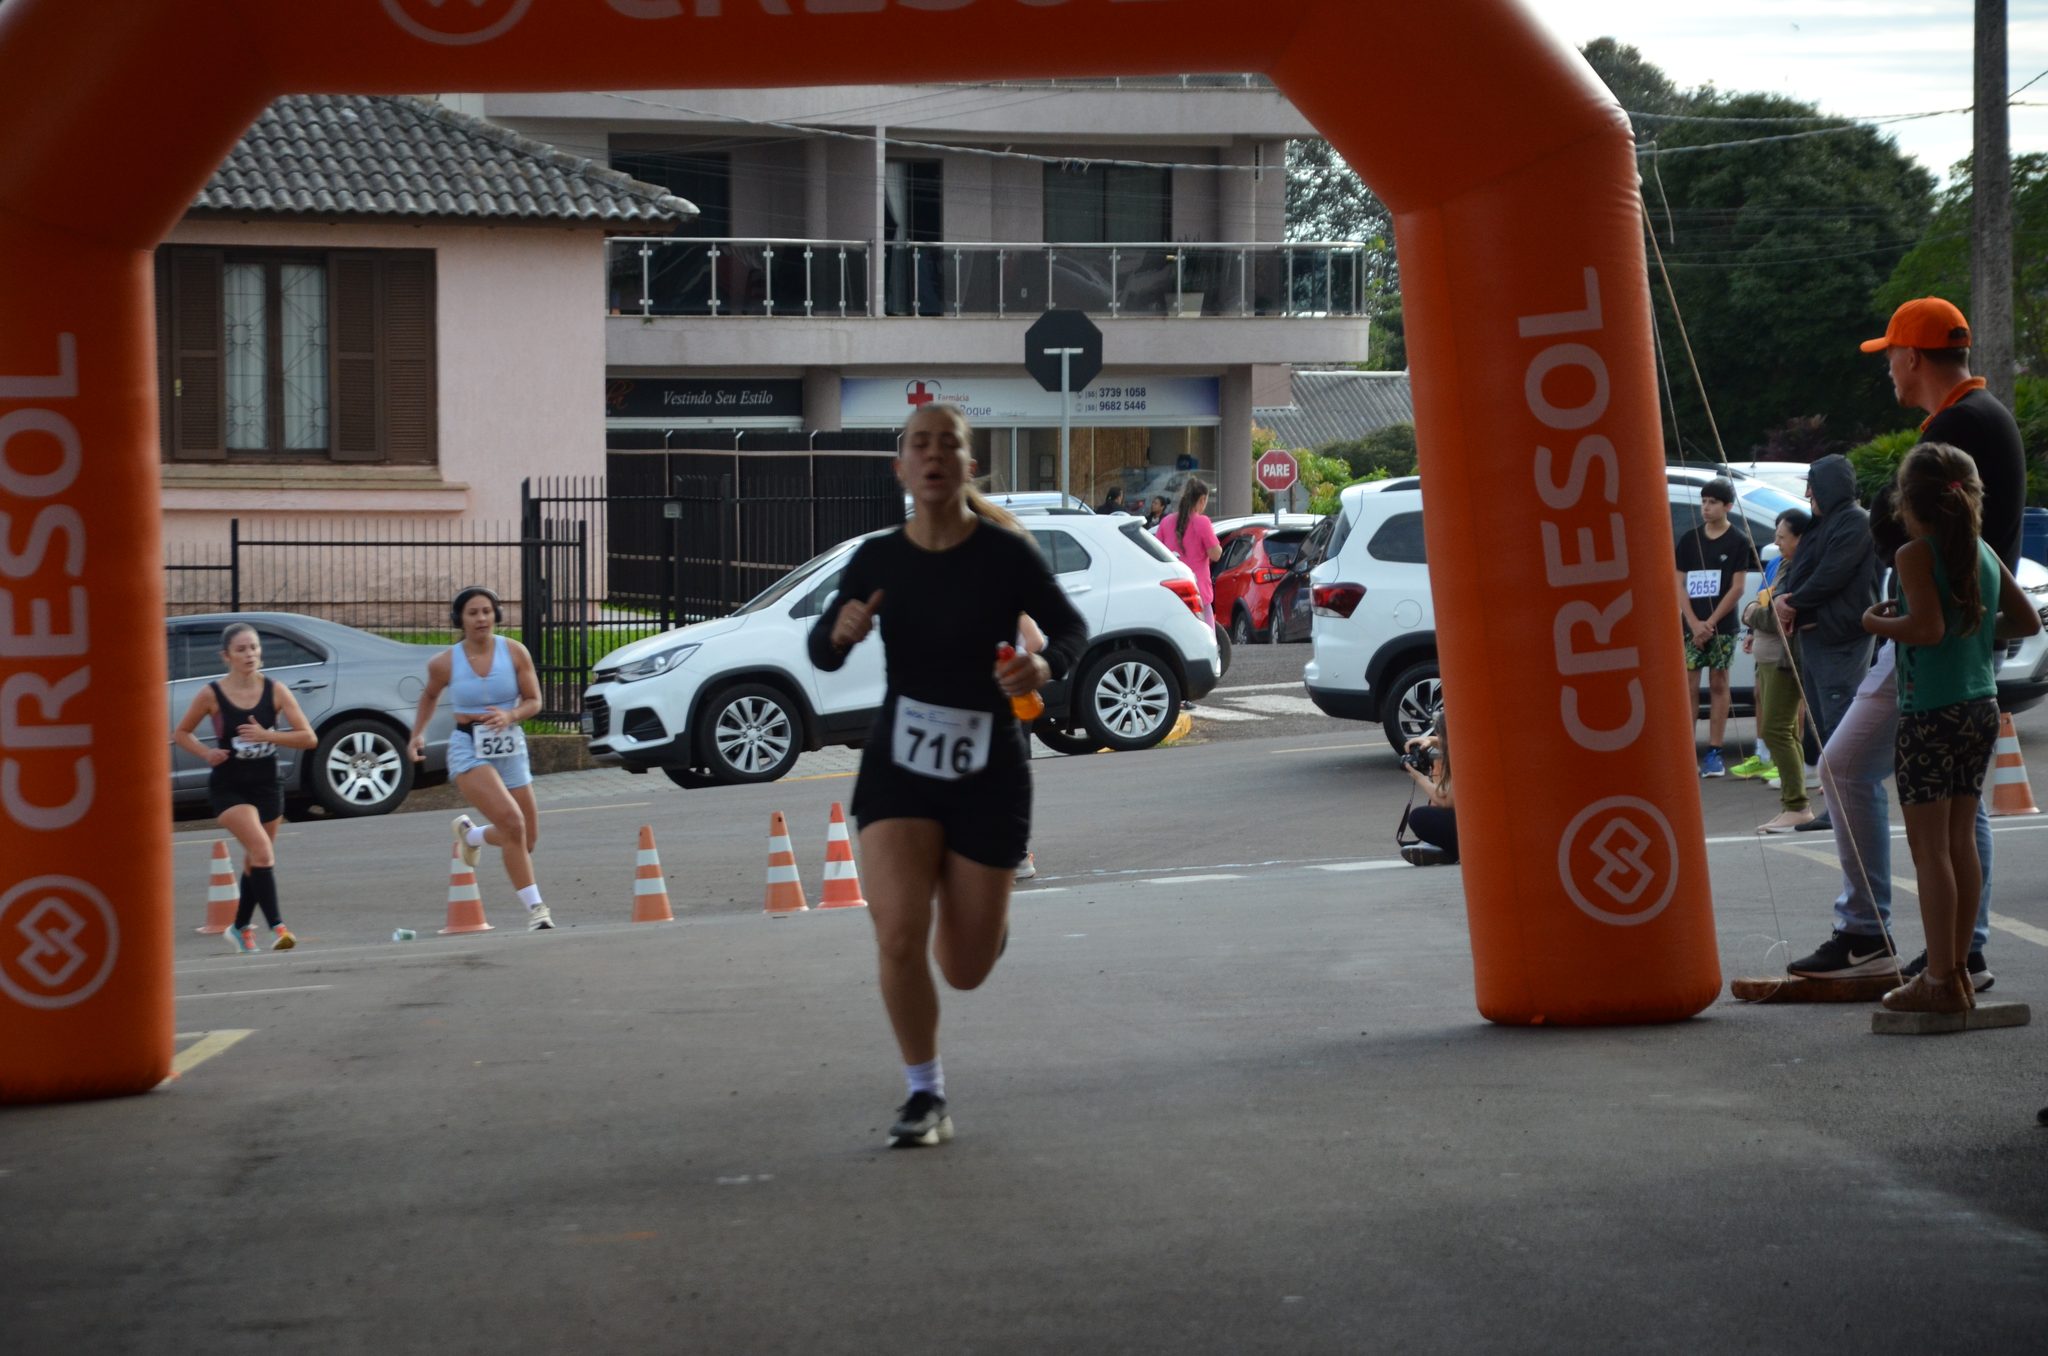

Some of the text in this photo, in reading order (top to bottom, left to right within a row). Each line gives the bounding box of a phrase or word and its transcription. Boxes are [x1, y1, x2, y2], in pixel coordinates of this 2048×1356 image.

[663, 390, 773, 405] Vestindo Seu Estilo
[938, 393, 970, 402] Farmácia
[1099, 387, 1121, 397] 3739
[1124, 387, 1146, 397] 1058
[1099, 401, 1121, 411] 9682
[1124, 401, 1146, 410] 5446
[1263, 463, 1290, 477] PARE
[1518, 266, 1645, 752] CRESOL
[0, 331, 96, 831] CRESOL
[1689, 581, 1717, 596] 2655
[482, 736, 515, 755] 523
[906, 725, 975, 774] 716
